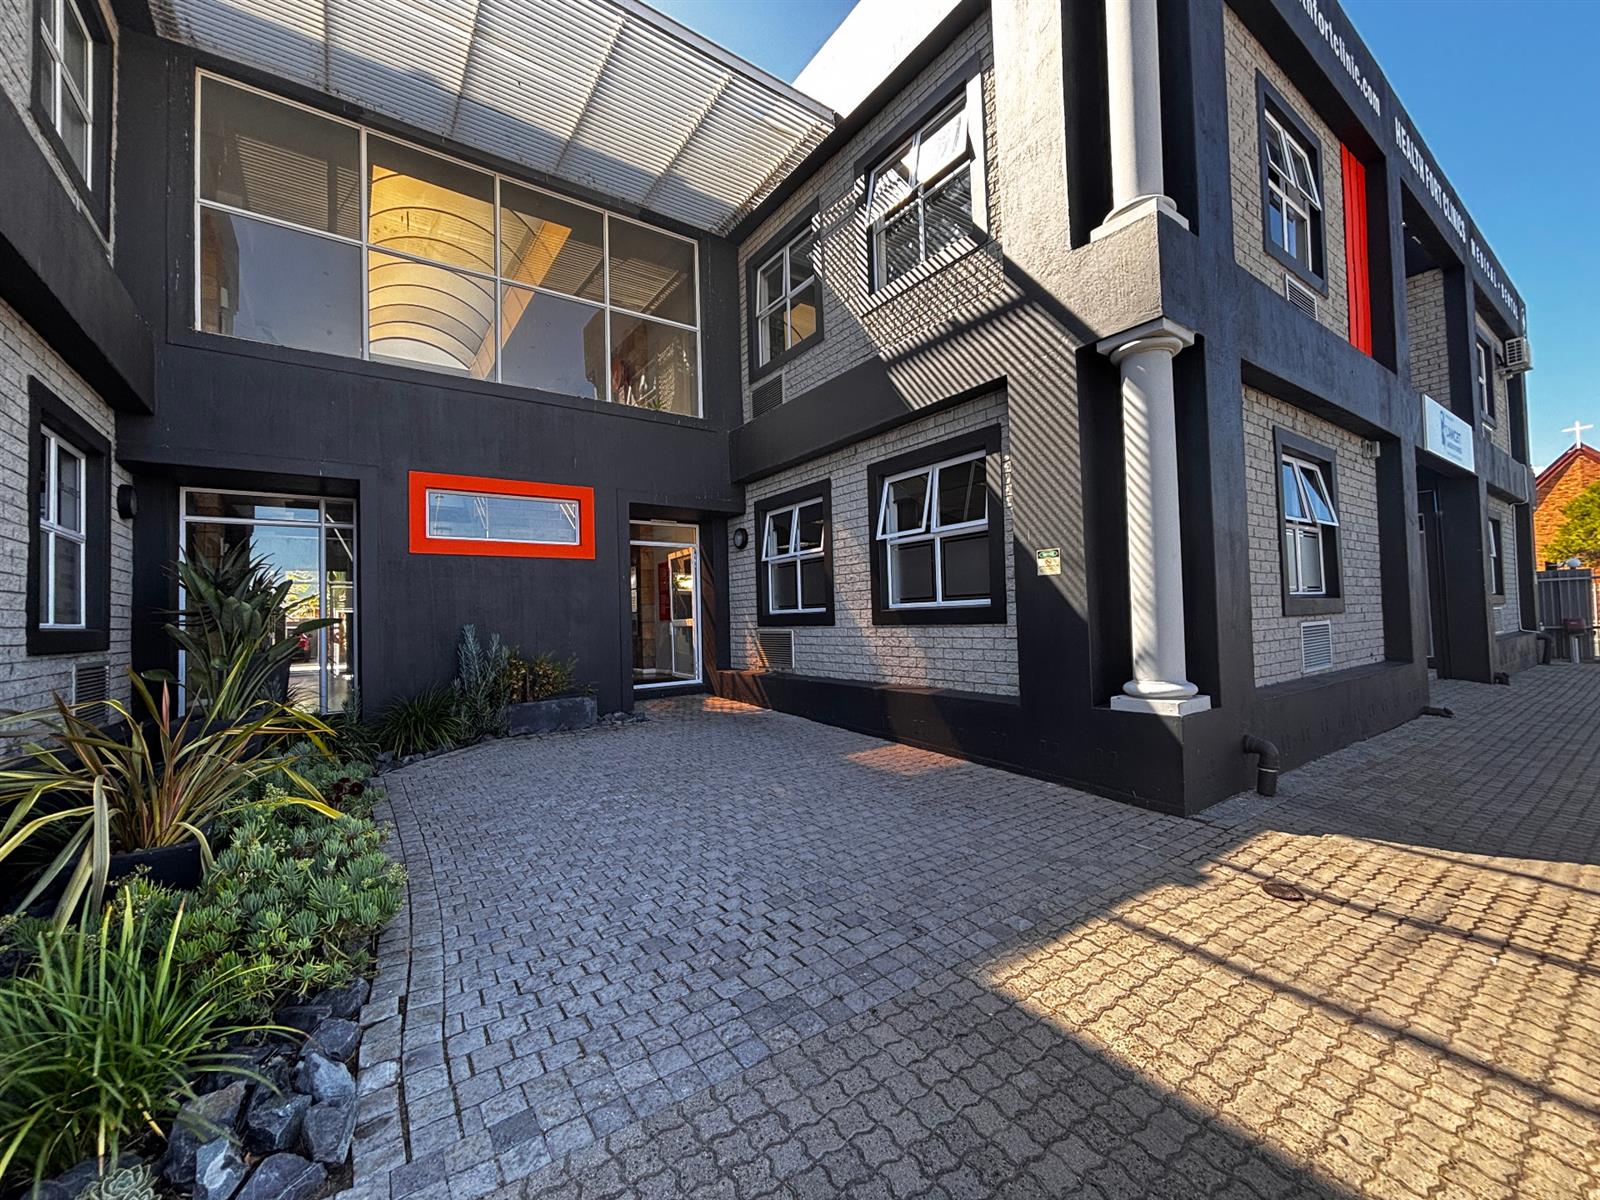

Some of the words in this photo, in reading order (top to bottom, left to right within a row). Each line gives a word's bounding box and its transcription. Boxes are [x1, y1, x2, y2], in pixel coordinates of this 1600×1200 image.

[1394, 117, 1425, 183] HEALTH
[1425, 164, 1442, 209] FORT
[1443, 192, 1467, 243] CLINICS
[1470, 238, 1497, 288] MEDICAL
